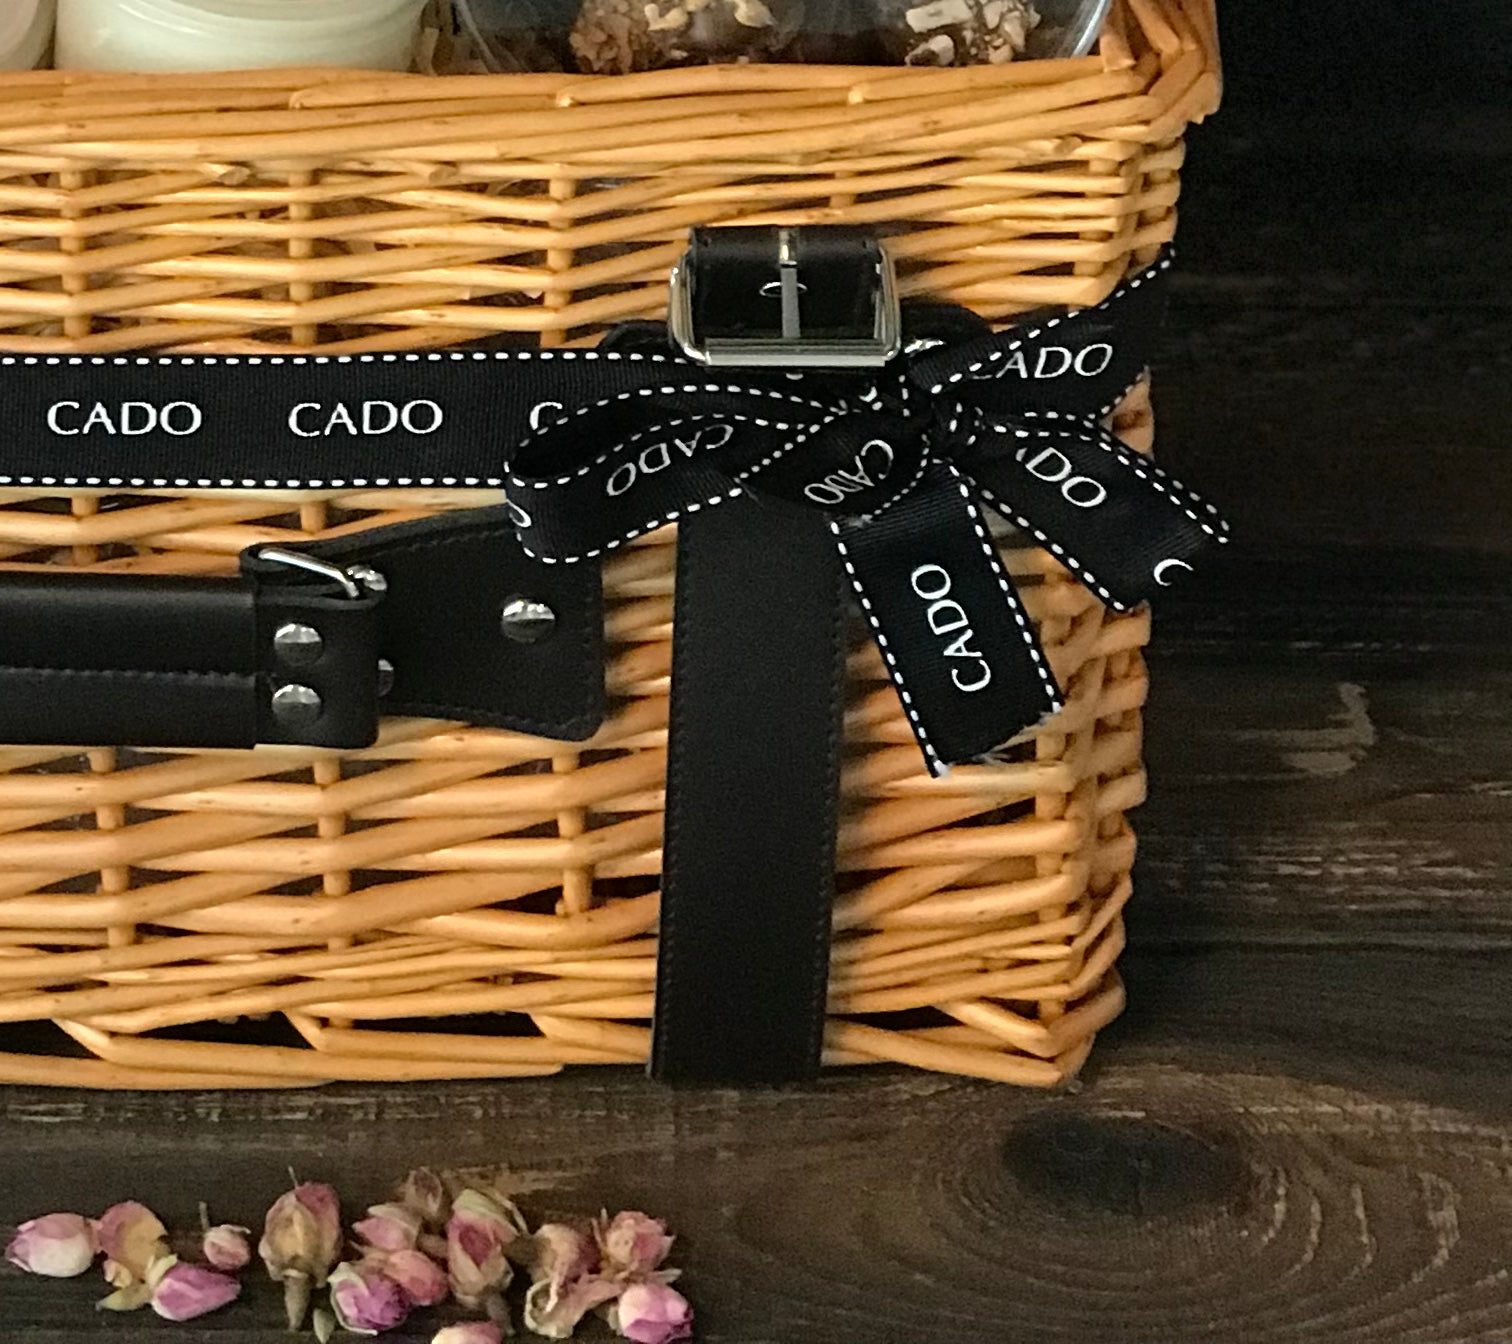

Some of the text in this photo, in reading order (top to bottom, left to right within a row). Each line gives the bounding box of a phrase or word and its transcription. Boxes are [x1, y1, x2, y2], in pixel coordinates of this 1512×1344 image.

[47, 401, 202, 436] CADO
[288, 399, 443, 437] CADO
[606, 424, 734, 496] CADO
[804, 439, 894, 504] CADO
[1015, 446, 1108, 508] DO
[911, 564, 992, 693] CADO
